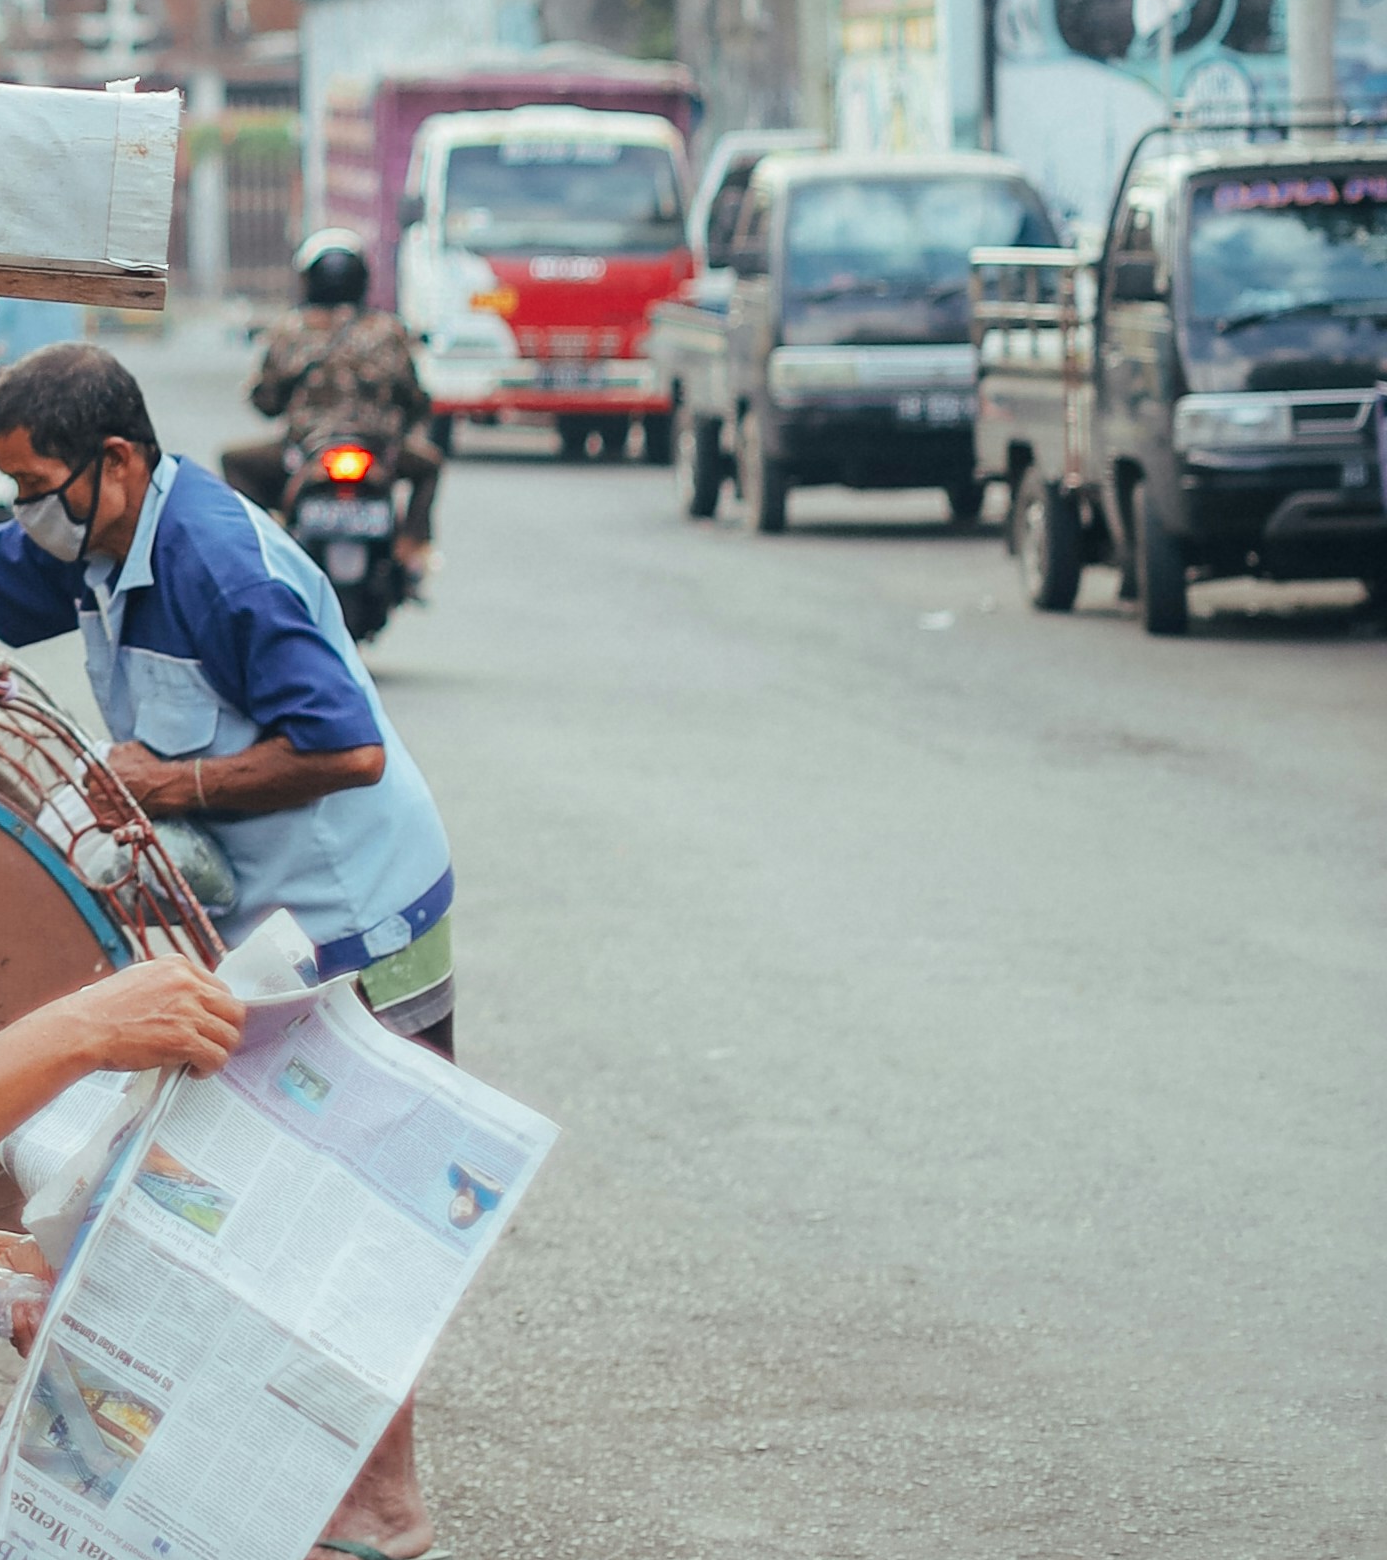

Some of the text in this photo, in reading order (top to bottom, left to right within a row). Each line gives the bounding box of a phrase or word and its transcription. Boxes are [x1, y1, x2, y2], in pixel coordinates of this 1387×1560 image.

[94, 1333, 119, 1356] Siap
[112, 1347, 134, 1367] Mal
[129, 1356, 163, 1385] Persen
